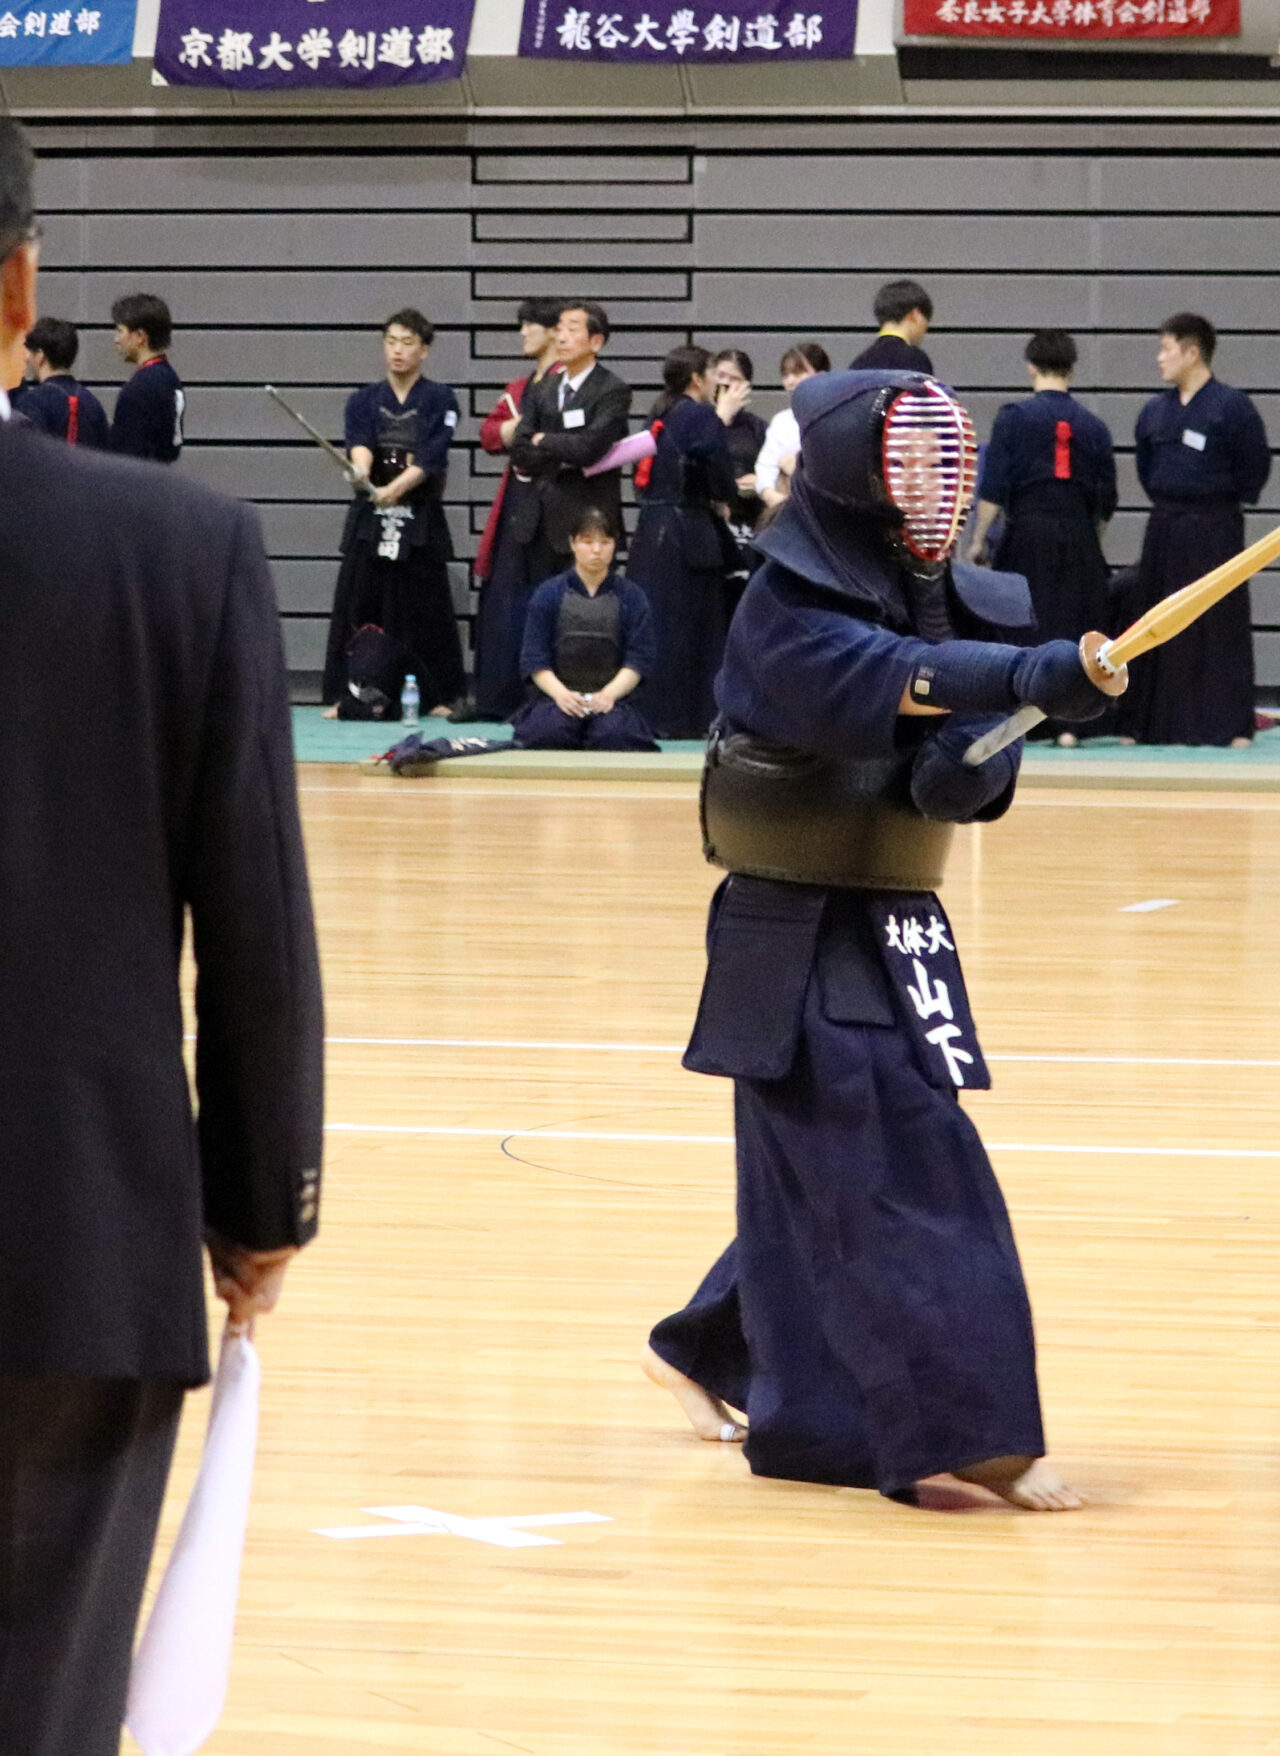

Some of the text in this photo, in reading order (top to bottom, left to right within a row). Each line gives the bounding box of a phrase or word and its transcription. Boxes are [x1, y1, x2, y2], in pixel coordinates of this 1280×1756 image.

[178, 25, 455, 71] 京都大学剣道部
[907, 958, 974, 1086] 山下
